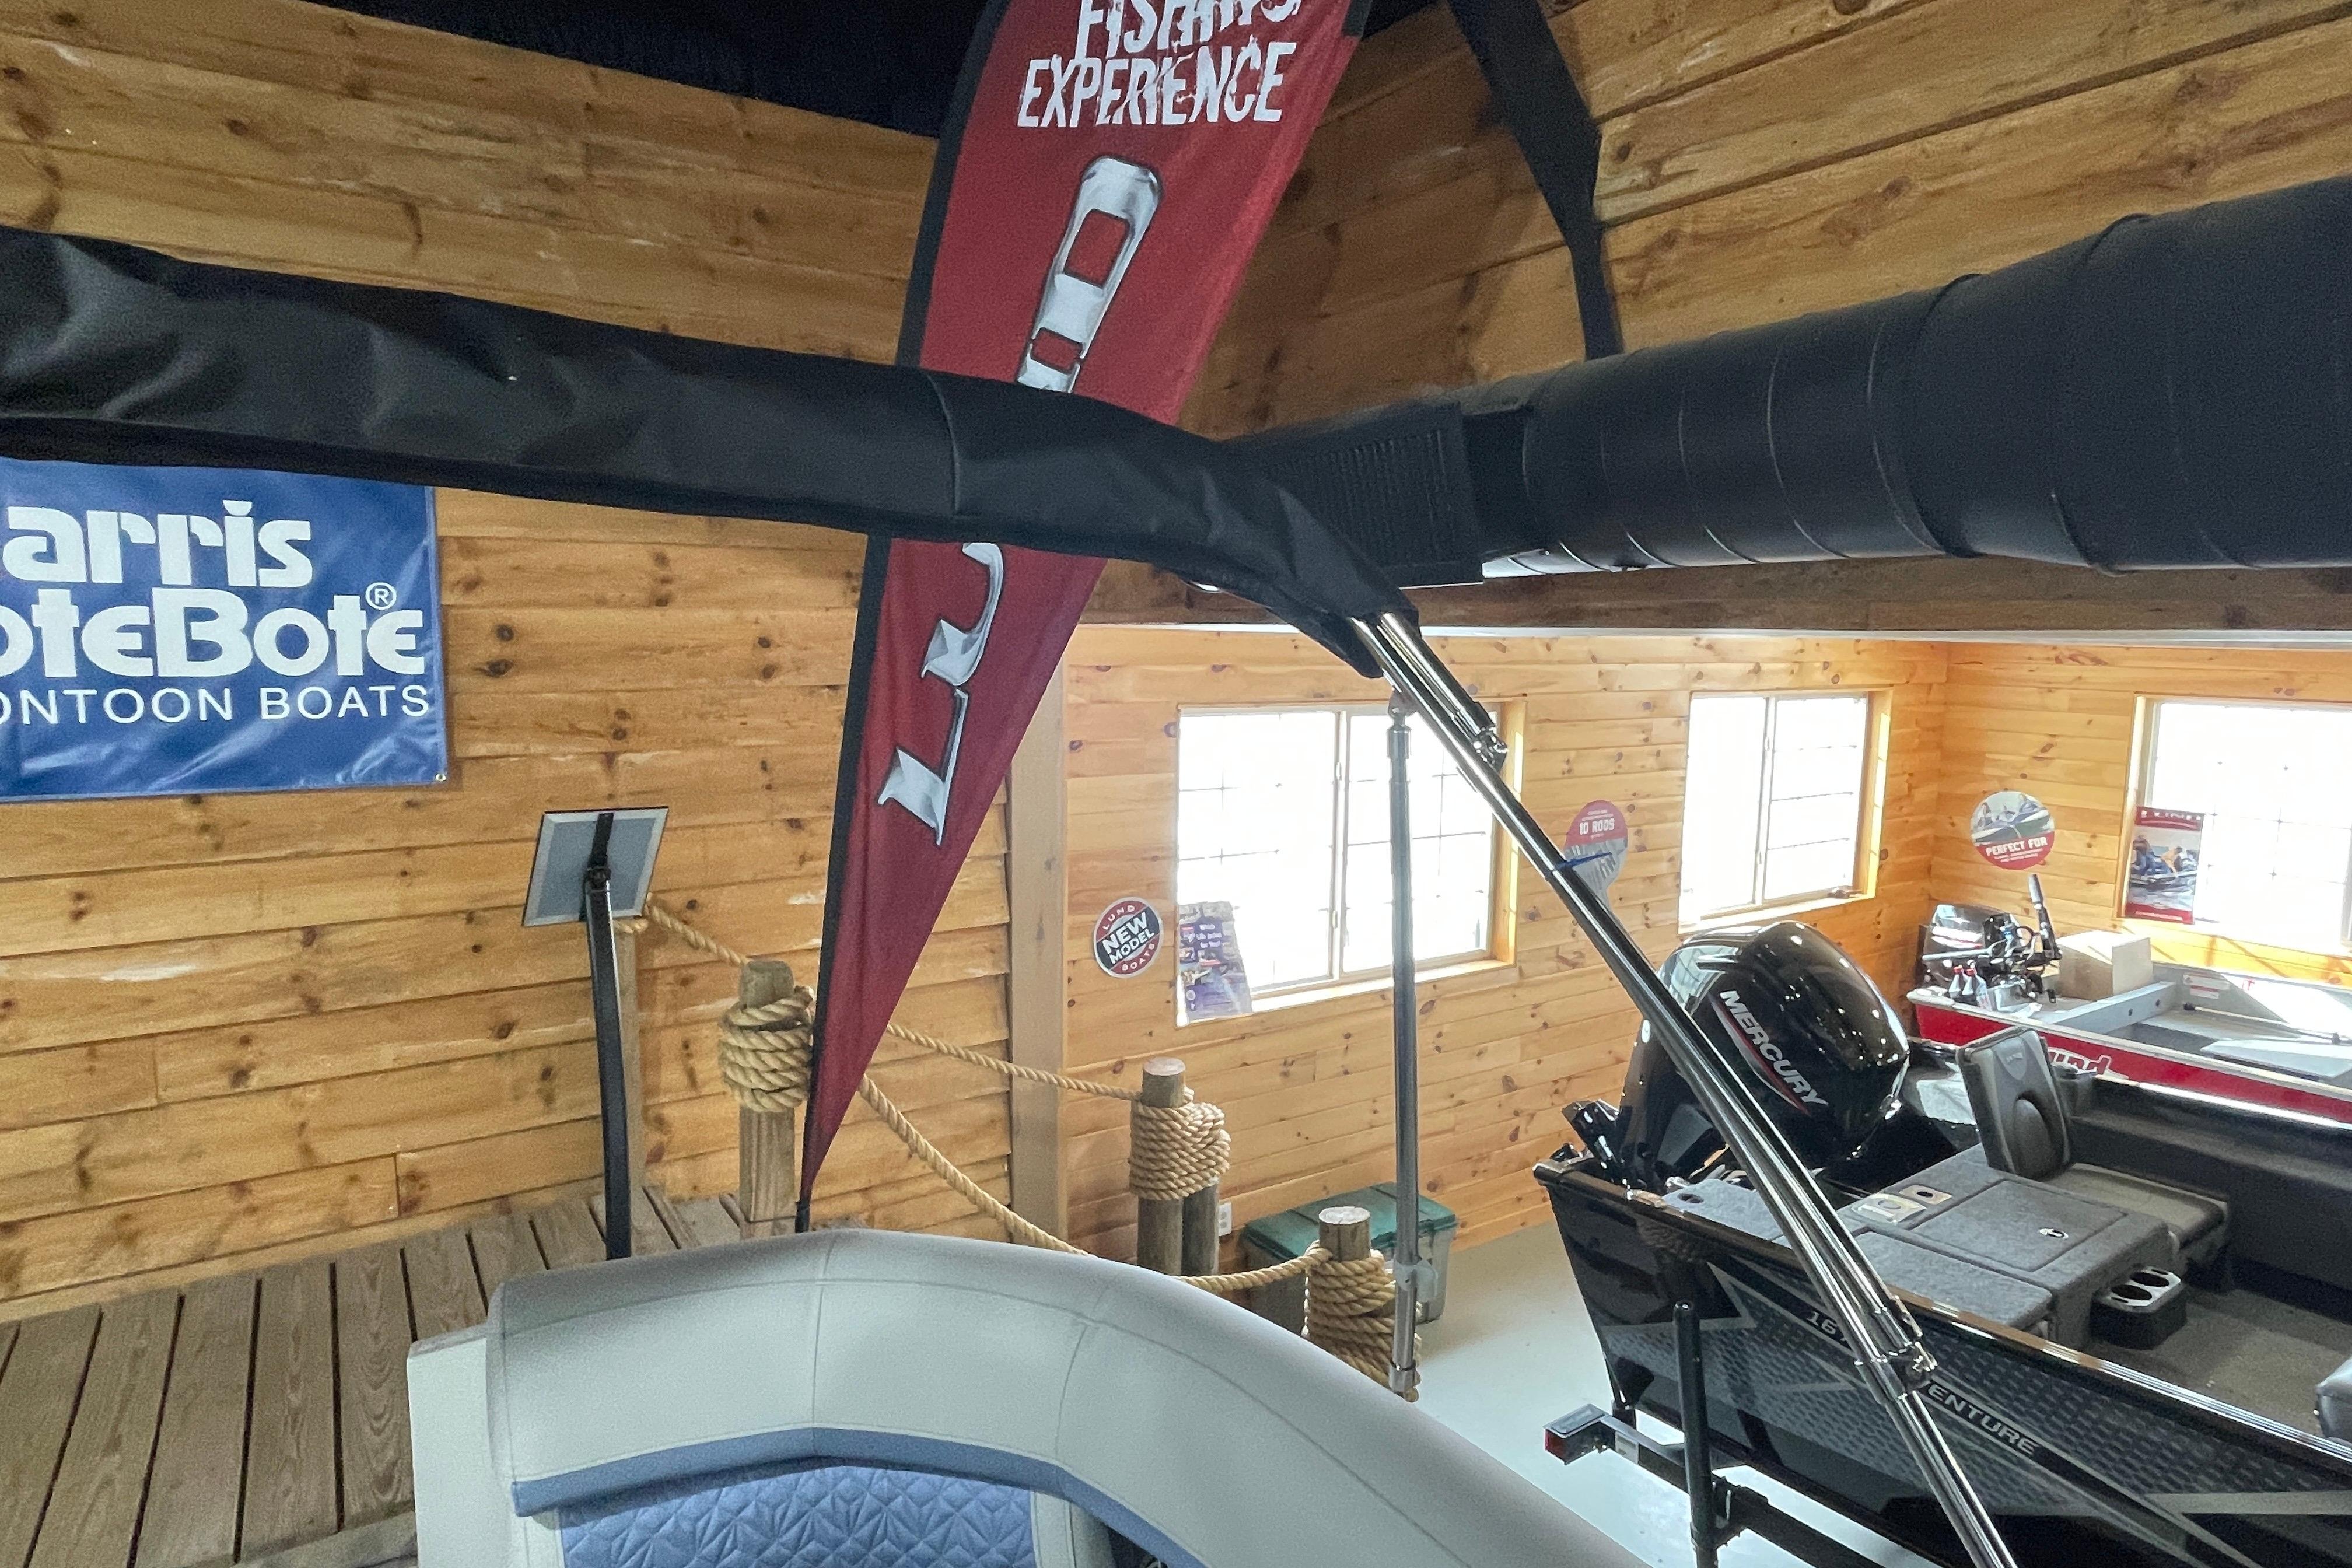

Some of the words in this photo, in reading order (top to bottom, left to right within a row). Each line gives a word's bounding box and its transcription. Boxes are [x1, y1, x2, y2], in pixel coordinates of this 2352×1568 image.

[1017, 36, 1297, 128] EXPERIENCE
[260, 685, 429, 720] BOATS
[1591, 818, 1615, 833] RODS
[1985, 841, 2025, 856] PERFECT
[2028, 836, 2048, 848] FOR
[1102, 904, 1135, 930] LUND
[1102, 911, 1148, 954] NEW
[1110, 929, 1155, 964] MODEL
[1121, 943, 1156, 971] BOATS
[1719, 991, 1829, 1106] MERCURY
[1806, 1311, 1841, 1337] 16
